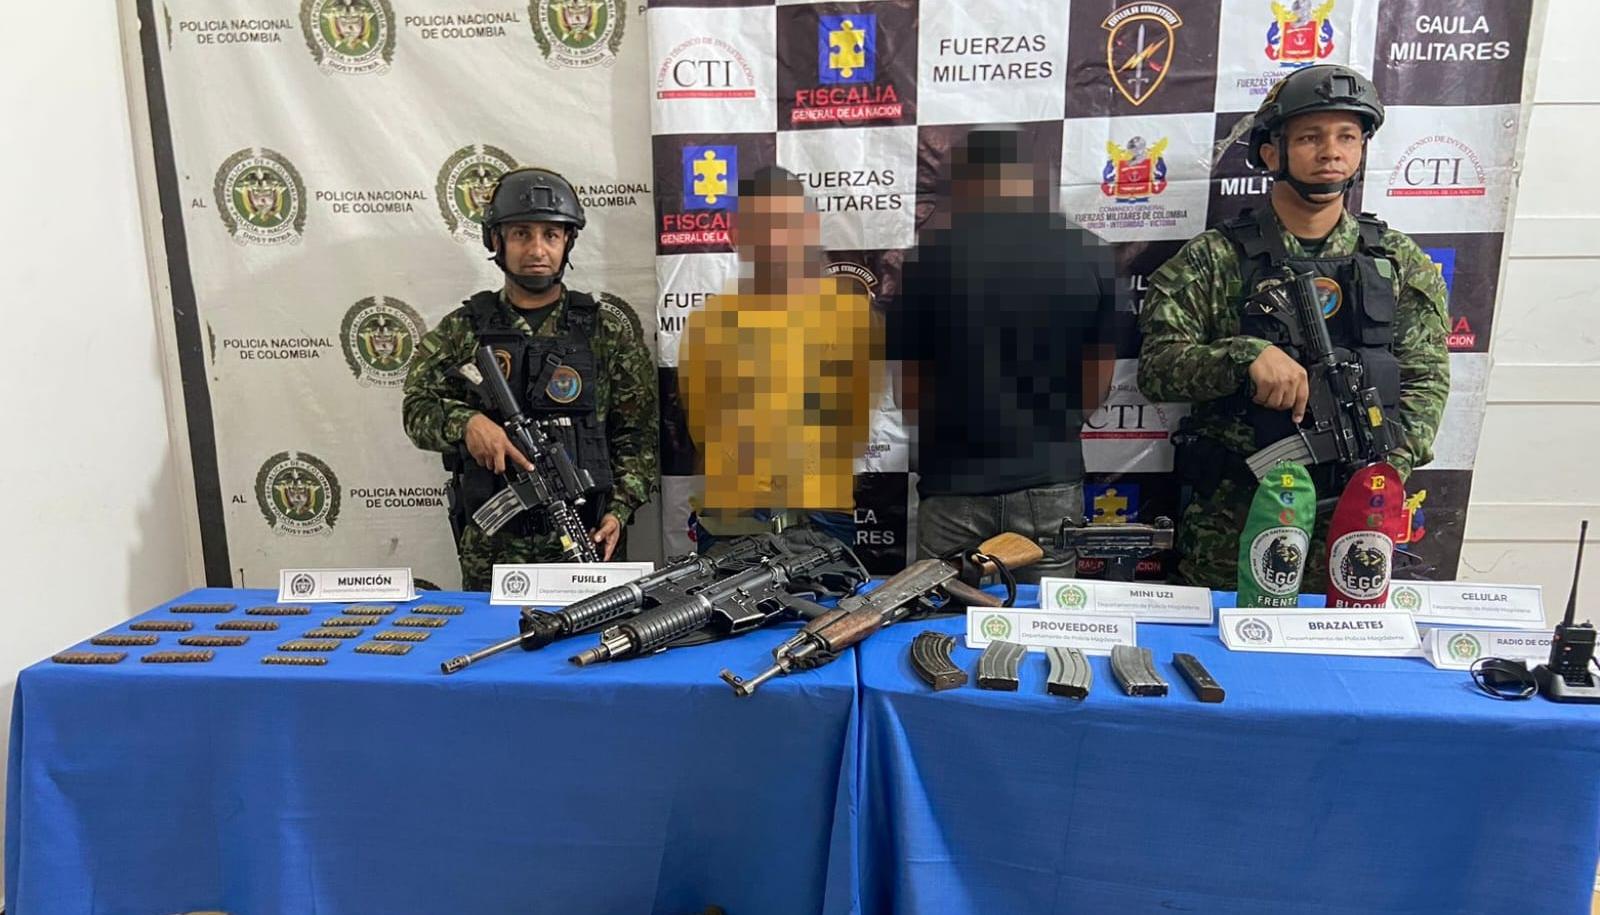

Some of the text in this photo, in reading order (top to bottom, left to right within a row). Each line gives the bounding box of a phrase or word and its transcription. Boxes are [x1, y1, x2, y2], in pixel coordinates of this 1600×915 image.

[180, 19, 293, 31] POLICIA NACIONAL
[405, 12, 520, 26] POLICIA NACIONAL
[1415, 15, 1489, 34] GAULA
[197, 32, 281, 44] DE COLOMBIA
[422, 26, 505, 39] DE COLOMBIA
[940, 35, 1046, 55] FUERZAS
[1390, 41, 1511, 61] MILITARES
[673, 59, 734, 88] CTI
[933, 61, 1053, 82] MILITARES
[792, 108, 835, 120] GENERAL
[836, 108, 849, 119] DE
[851, 108, 865, 118] LA
[1434, 135, 1446, 143] DE
[1404, 157, 1464, 186] CTI
[797, 169, 895, 188] FUERZAS
[589, 184, 651, 195] NACIONAL
[316, 190, 427, 202] POLICIA NACIONAL
[582, 196, 637, 208] OLOMBIA
[333, 202, 413, 214] DE COLOMBIA
[816, 194, 902, 213] LITARES
[663, 212, 731, 231] FISCA
[1075, 209, 1188, 222] FUERZAS MILITARES DE COLOMBIA
[660, 231, 729, 244] GENERAL DE LA
[224, 337, 334, 349] POLICIA NACIONAL
[240, 349, 320, 360] DE COLOMBIA
[351, 487, 396, 498] POLICIA
[232, 494, 248, 504] AL
[366, 498, 444, 508] DE COLOMBIA
[338, 574, 392, 586] MUNICIÓN
[571, 575, 607, 584] FUSILES
[1265, 567, 1297, 585] EGC
[1347, 575, 1382, 590] EGC
[1130, 590, 1174, 599] MINI UZI
[1461, 592, 1508, 602] CELULAR
[1032, 621, 1119, 634] PROVEEDORES
[1308, 620, 1384, 631] BRAZALETES
[1497, 638, 1523, 646] RADIO
